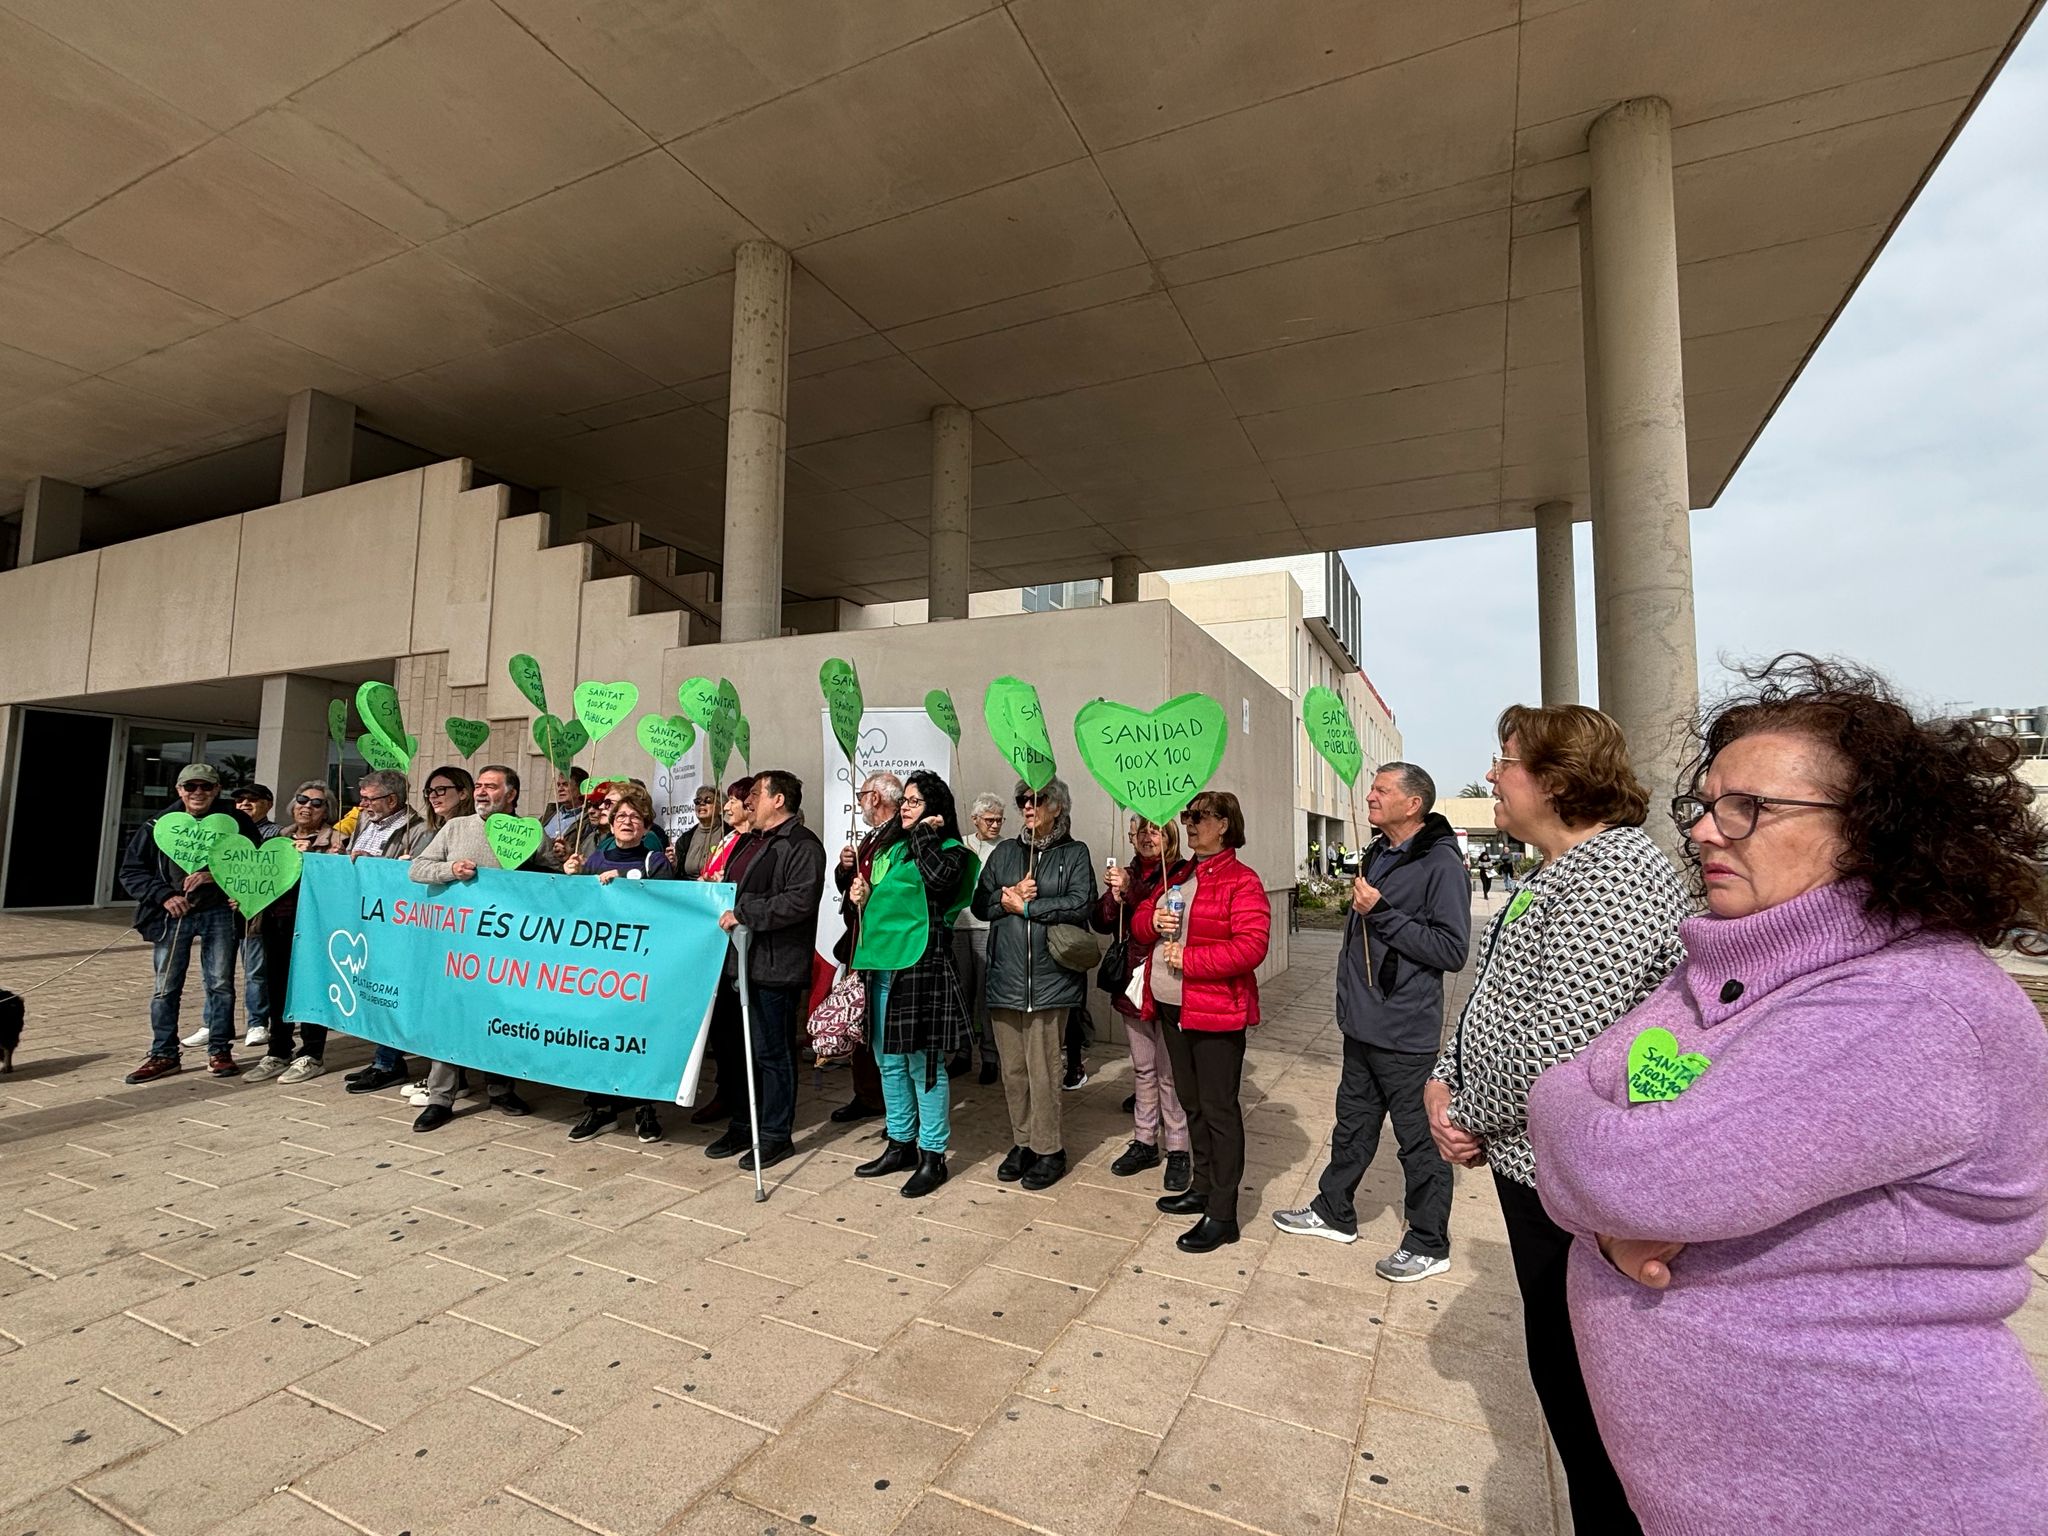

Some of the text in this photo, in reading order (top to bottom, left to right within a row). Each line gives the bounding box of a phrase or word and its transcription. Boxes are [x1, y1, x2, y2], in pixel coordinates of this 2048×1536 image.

[221, 849, 280, 865] SANITAT
[361, 896, 650, 957] LA SANITAT ÉS UN DRET,
[353, 976, 399, 996] PLATAFORMA
[445, 951, 648, 1003] NO UN NEGOCI
[487, 1018, 647, 1055] ¡Gestió pública JA!
